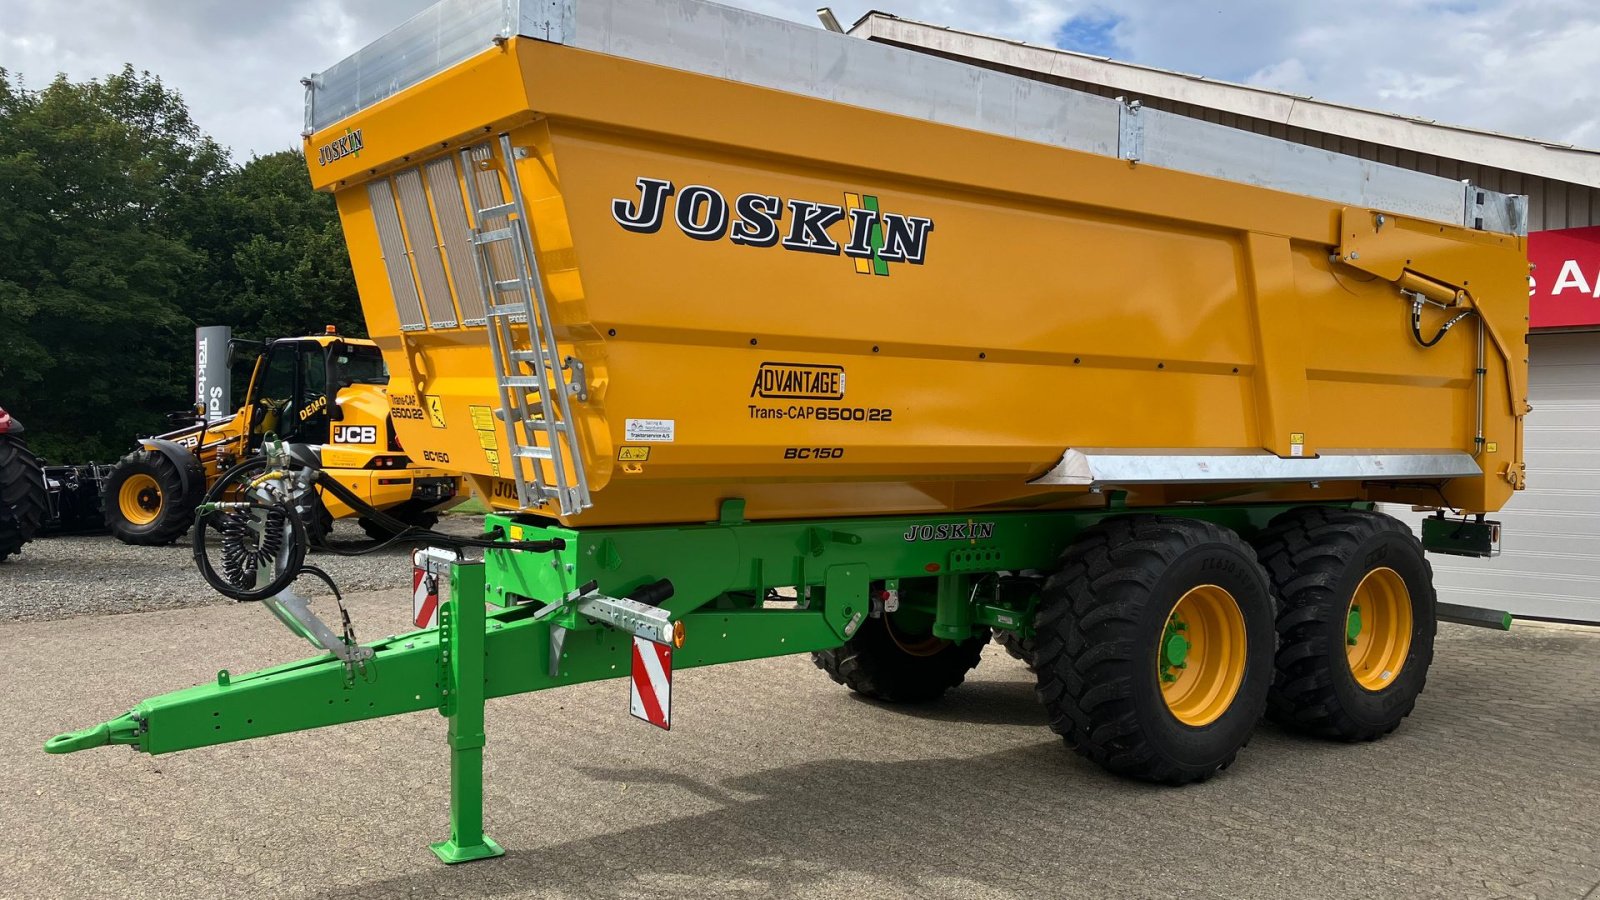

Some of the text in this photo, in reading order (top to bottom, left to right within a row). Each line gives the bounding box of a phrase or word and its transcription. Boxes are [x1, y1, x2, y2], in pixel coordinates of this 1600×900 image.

[318, 129, 364, 166] JOSKIN
[611, 177, 934, 265] JOSKIN
[750, 368, 838, 397] ADVANTAGE
[299, 396, 327, 421] DEMO
[176, 436, 198, 448] CB
[334, 426, 376, 443] JCB
[423, 450, 450, 464] BC150
[784, 447, 844, 459] BC150
[903, 522, 995, 542] JOSKIN
